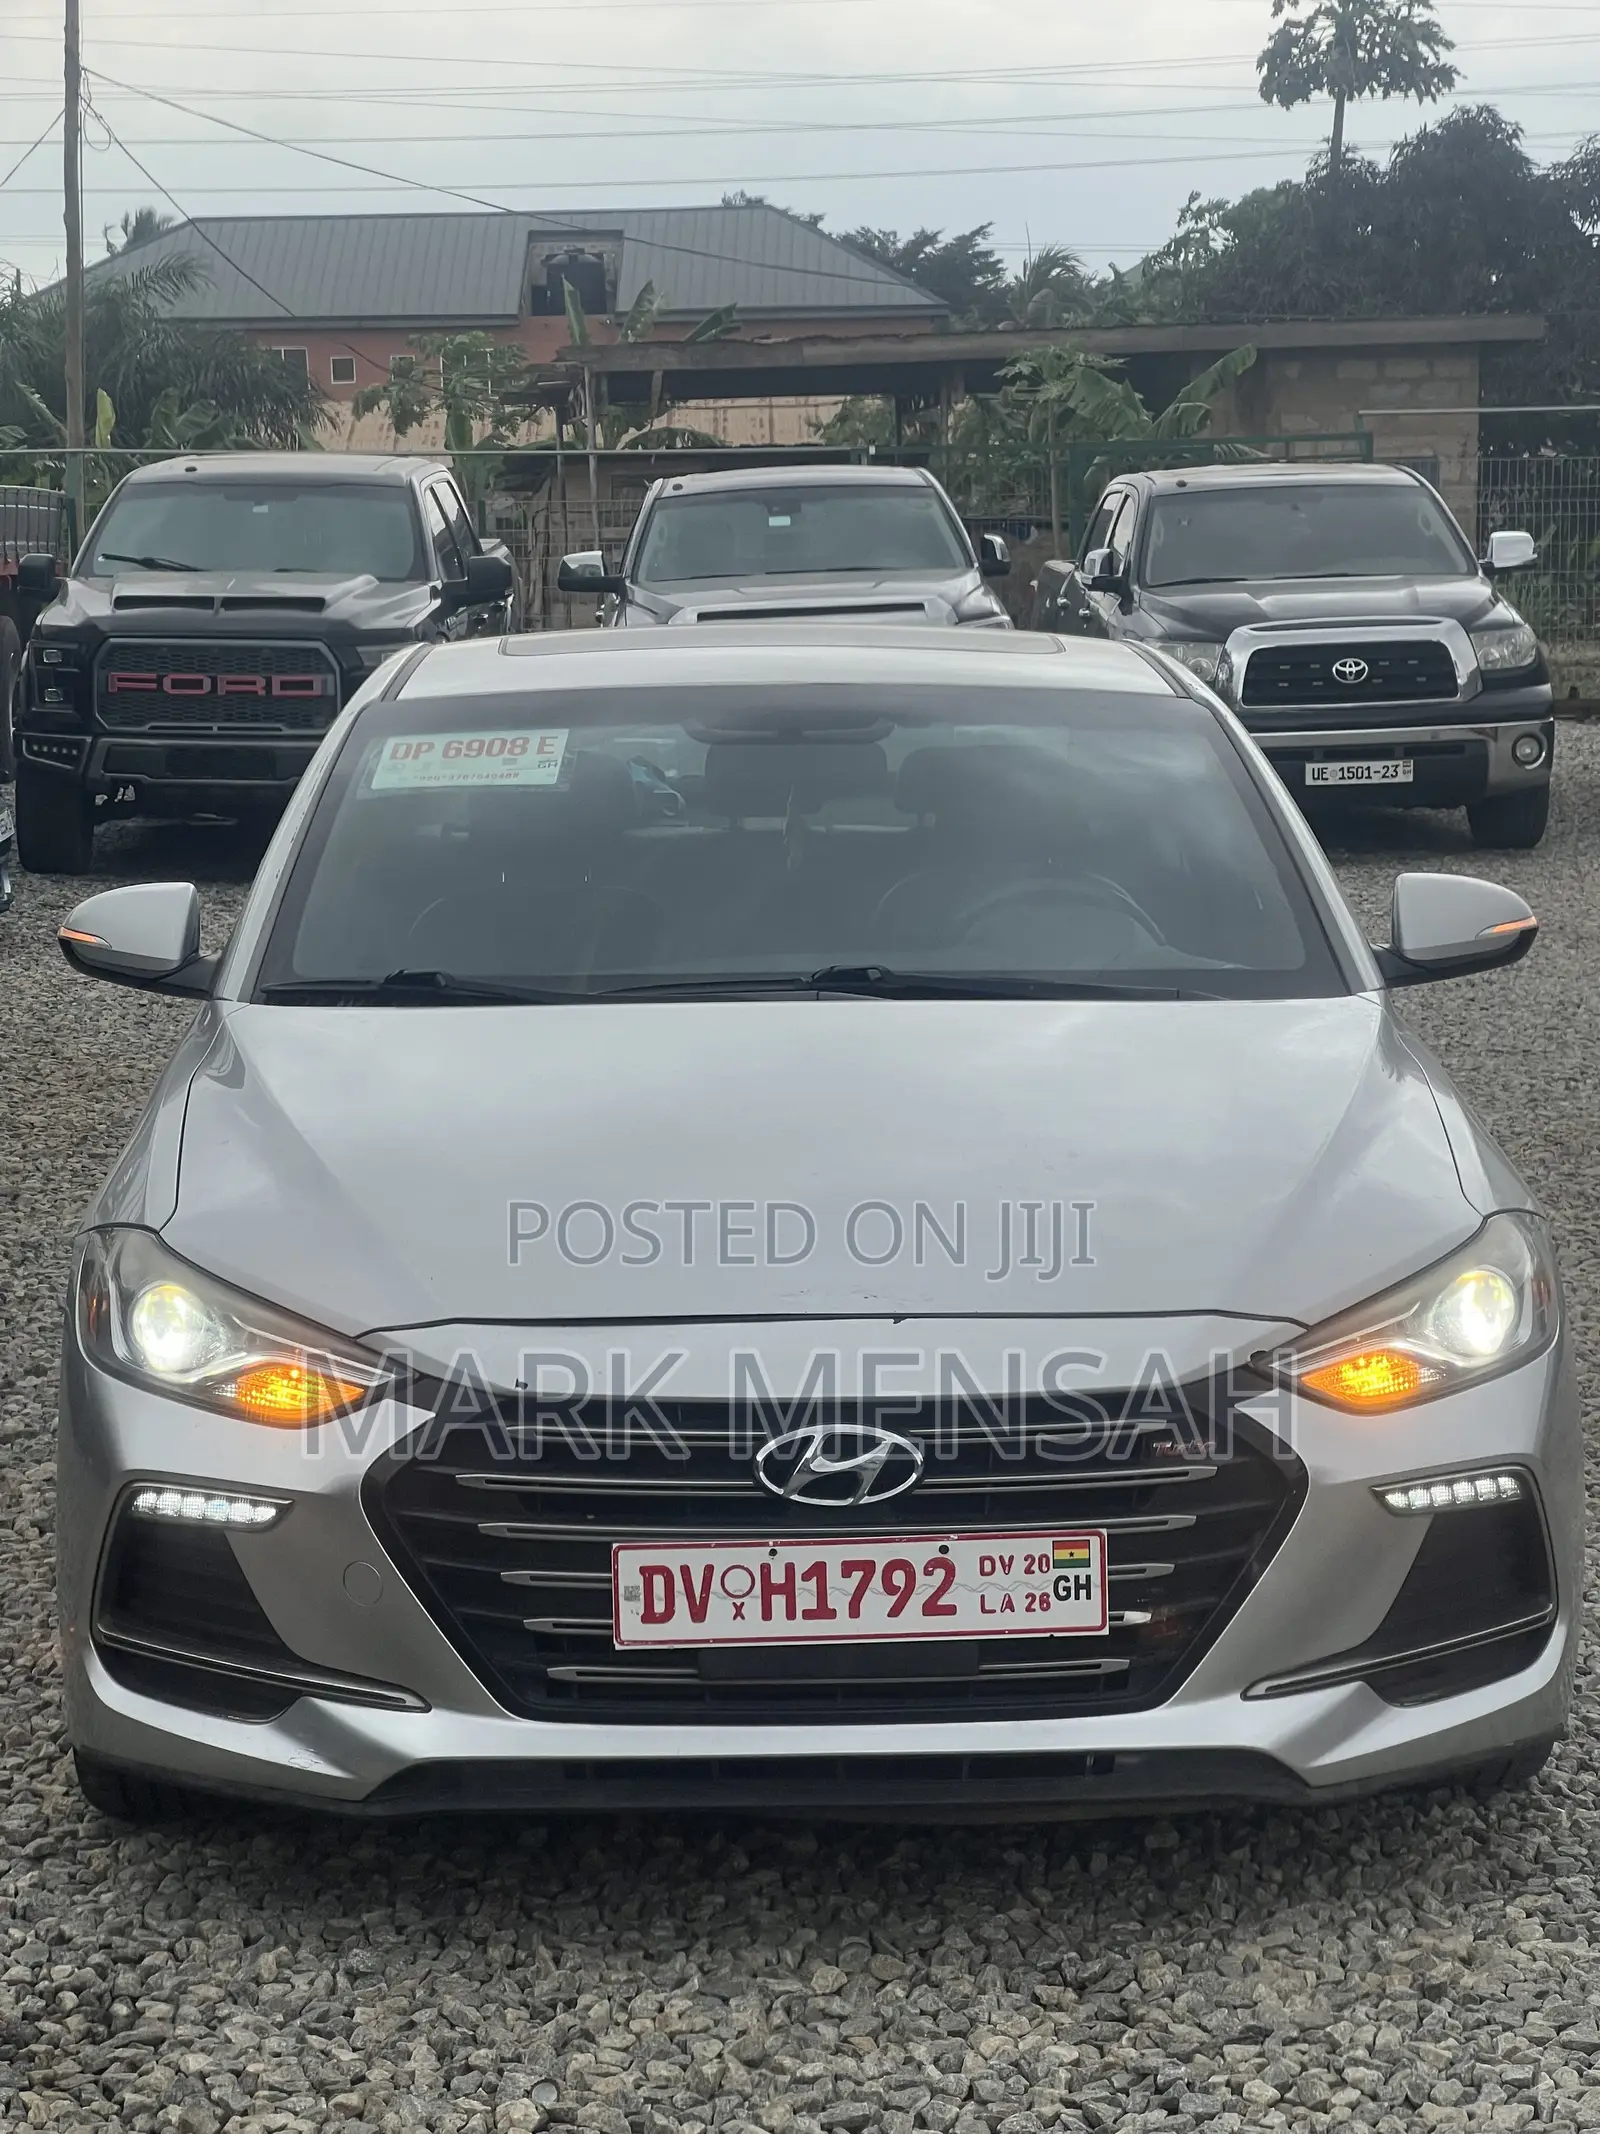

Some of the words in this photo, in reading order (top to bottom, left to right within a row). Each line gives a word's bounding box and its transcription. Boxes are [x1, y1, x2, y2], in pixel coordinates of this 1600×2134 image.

[108, 672, 323, 696] FORD
[390, 741, 435, 761] DP
[441, 737, 530, 759] 6908
[537, 736, 559, 755] E
[1312, 767, 1329, 781] UE
[1338, 764, 1400, 781] 1501-23
[979, 1554, 1015, 1576] DV
[1024, 1553, 1051, 1575] 20
[639, 1564, 714, 1624] DV
[760, 1556, 957, 1621] H1792
[1053, 1574, 1092, 1602] GH
[980, 1592, 1016, 1614] LA
